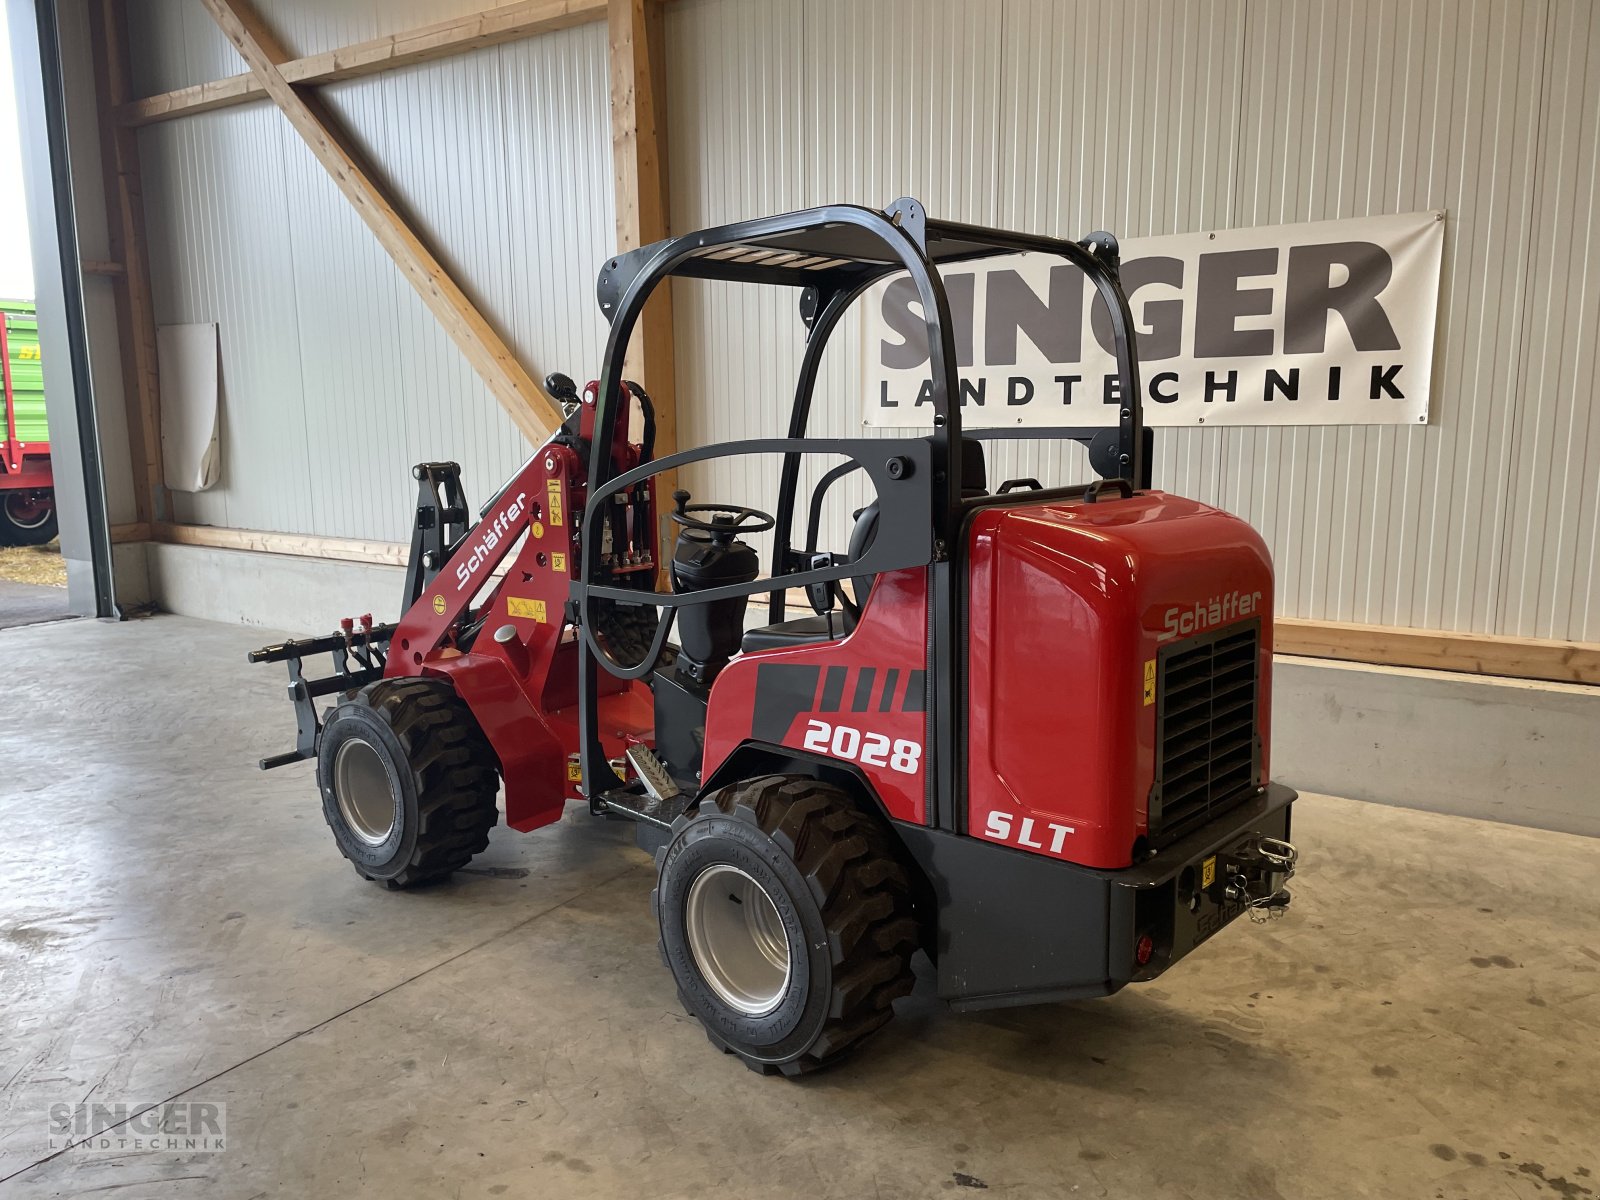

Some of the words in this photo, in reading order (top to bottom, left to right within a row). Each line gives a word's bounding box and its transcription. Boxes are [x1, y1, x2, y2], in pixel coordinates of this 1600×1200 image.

[881, 240, 1401, 370] SINGER
[880, 365, 1405, 408] LANDTECHNIK
[456, 492, 526, 591] Schäffer
[1157, 590, 1262, 642] Schäffer
[803, 719, 922, 775] 2028
[984, 810, 1075, 854] SLT
